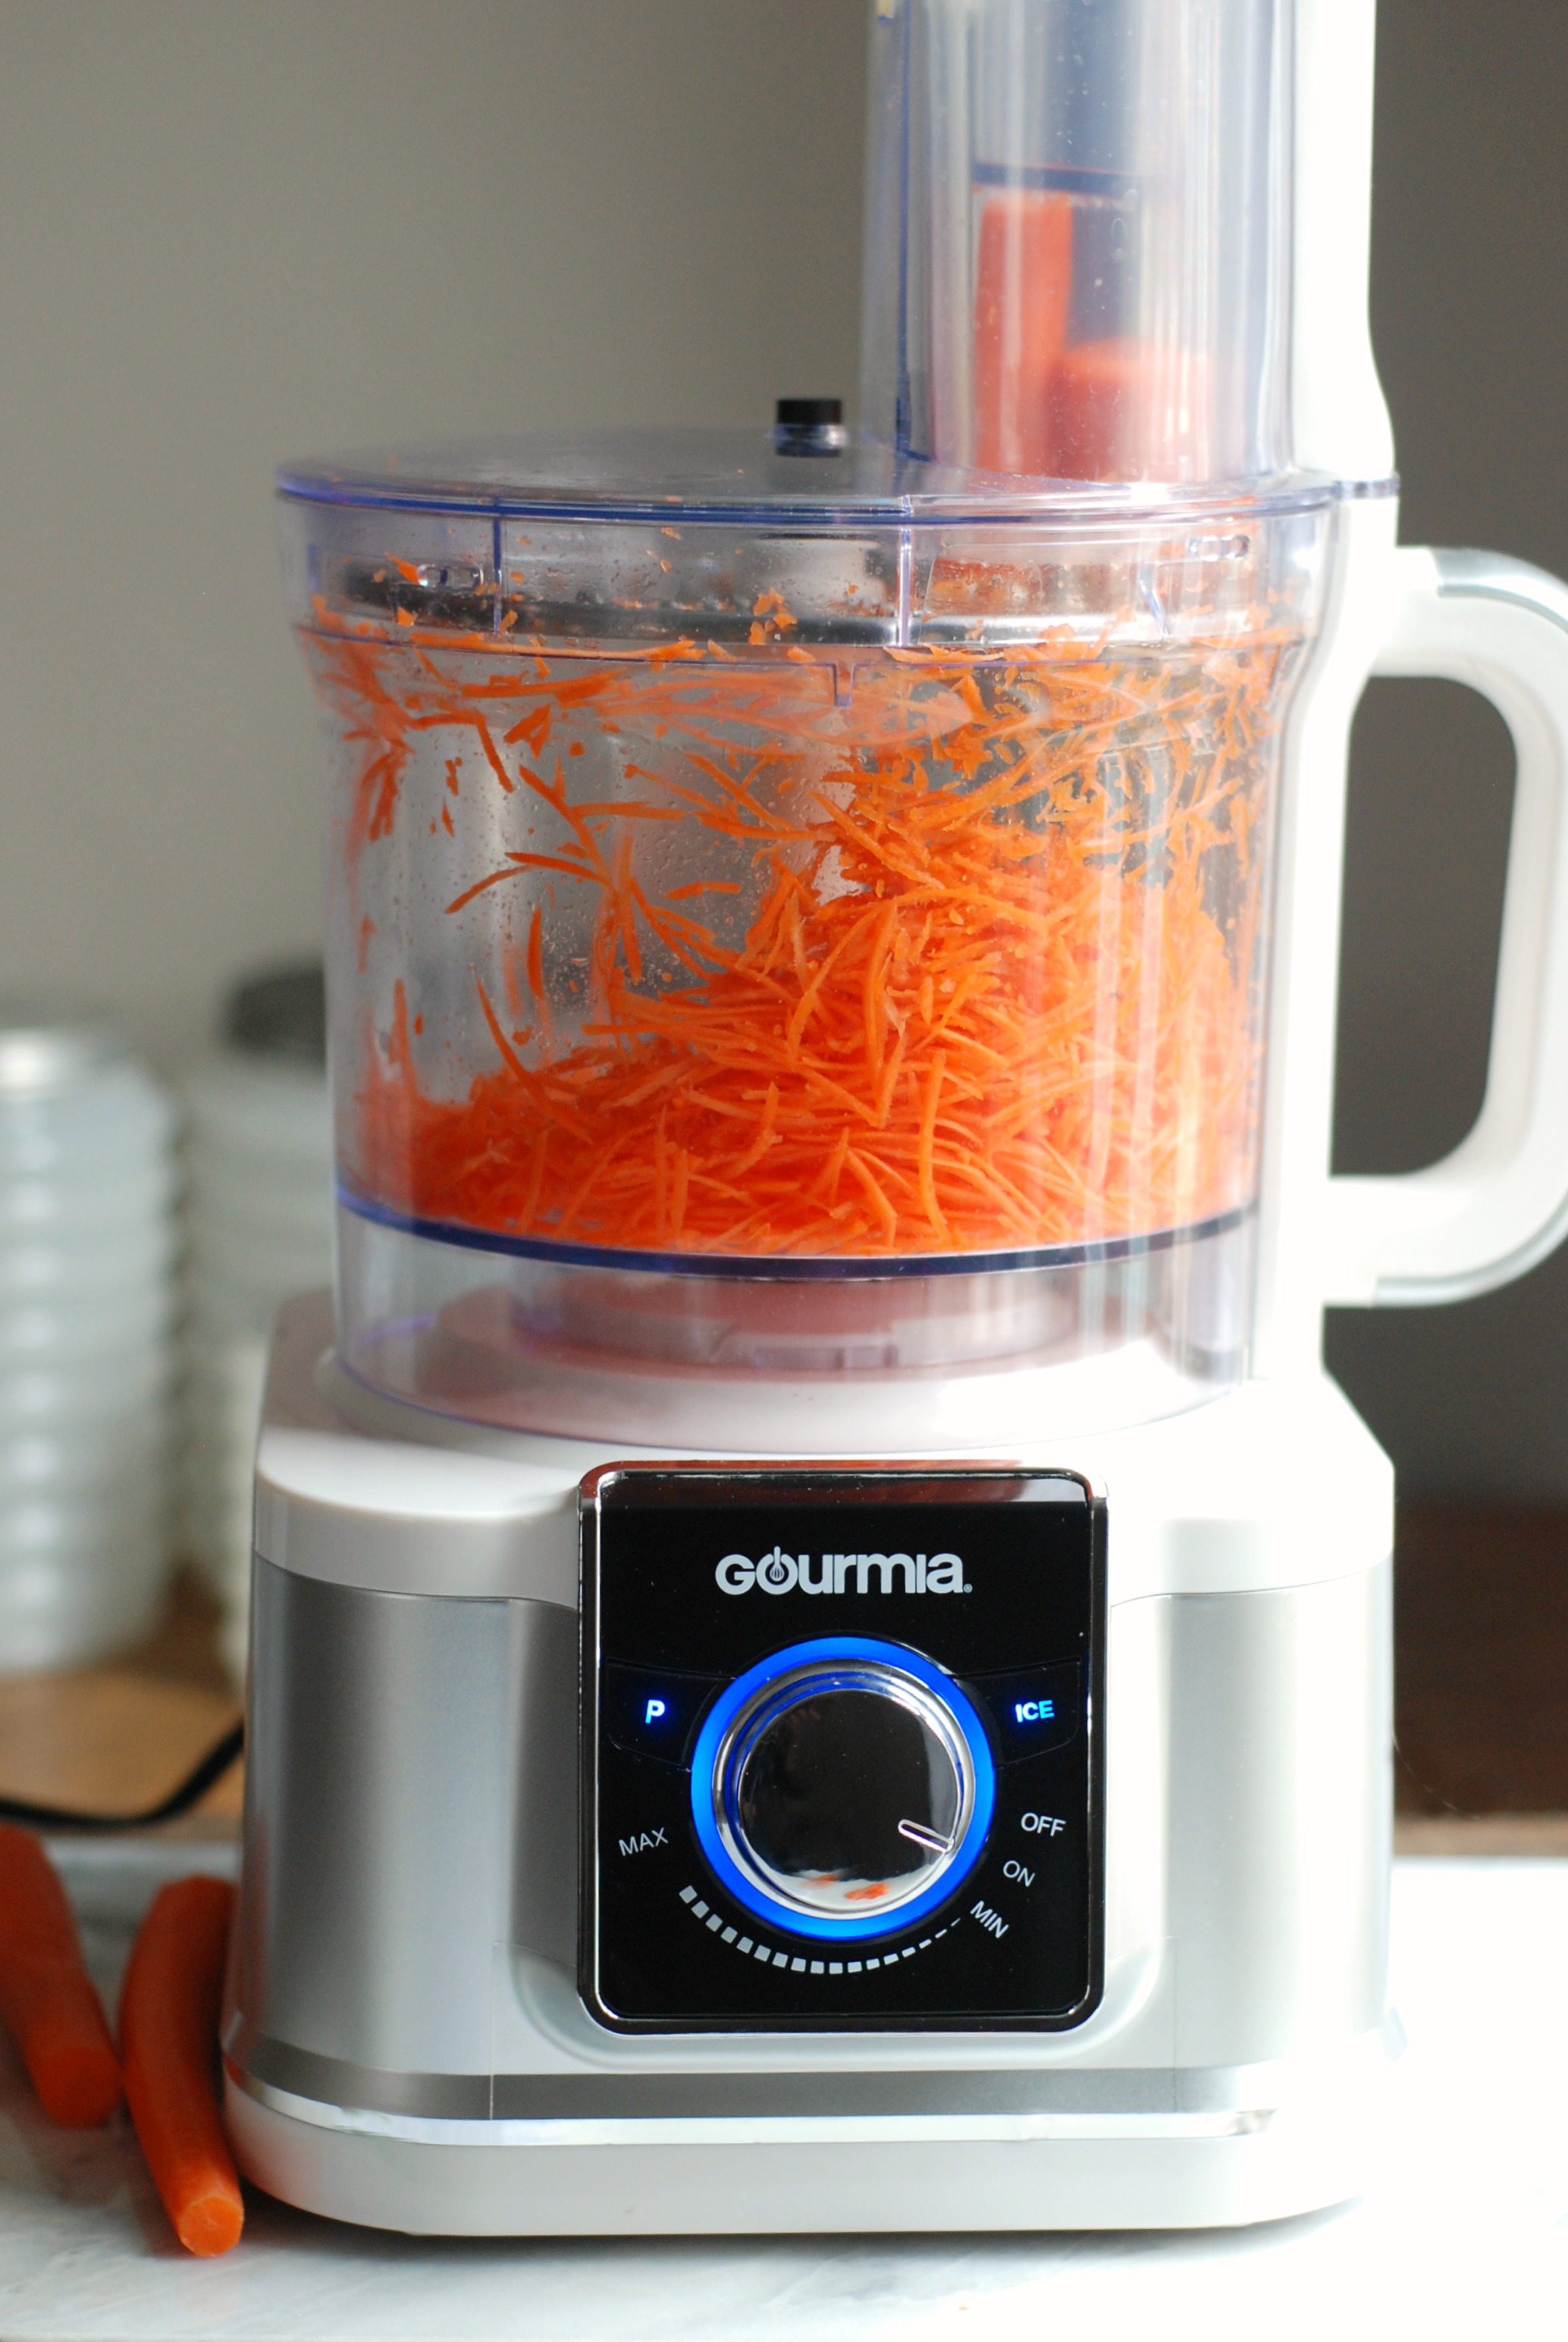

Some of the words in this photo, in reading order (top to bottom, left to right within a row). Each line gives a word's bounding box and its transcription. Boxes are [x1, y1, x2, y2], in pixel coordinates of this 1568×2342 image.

[644, 1698, 667, 1724] P
[1013, 1699, 1055, 1723] ICE
[1021, 1812, 1066, 1836] OFF
[619, 1828, 668, 1856] MAX
[1002, 1860, 1035, 1887] ON
[971, 1901, 1008, 1939] MIN
